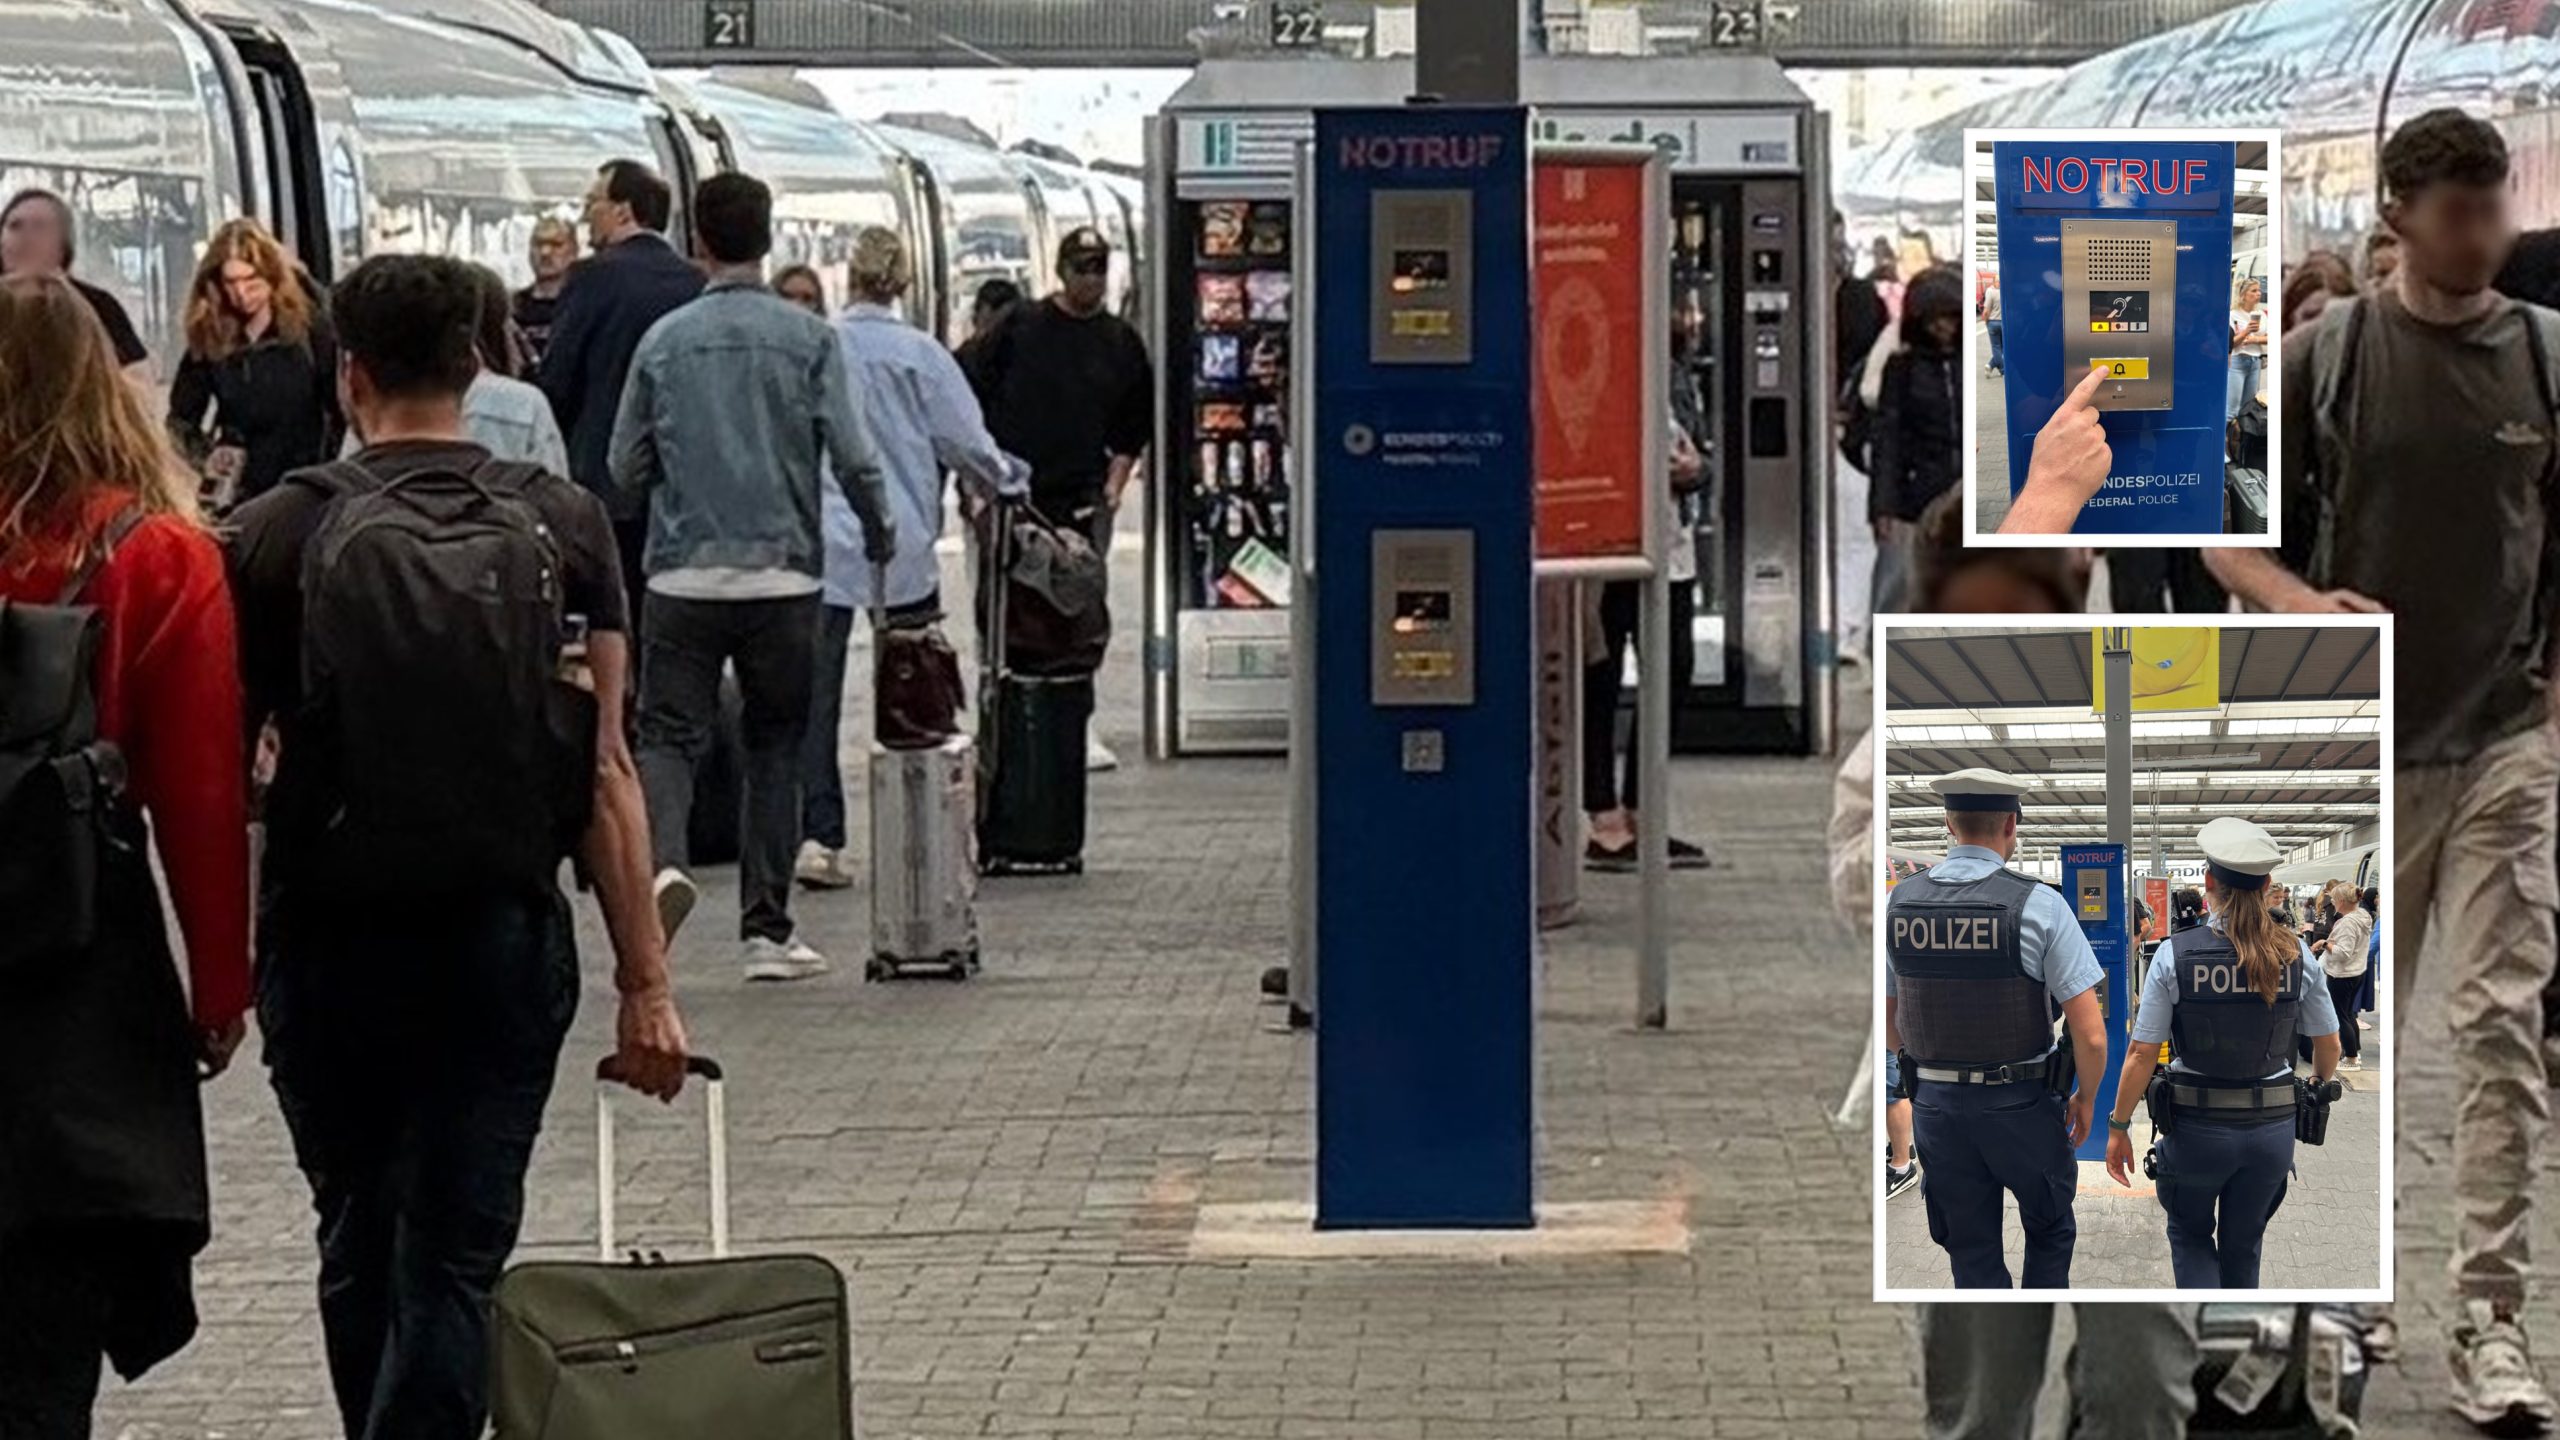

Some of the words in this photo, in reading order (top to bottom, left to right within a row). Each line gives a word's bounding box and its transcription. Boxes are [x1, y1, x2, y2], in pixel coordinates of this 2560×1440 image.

[714, 12, 746, 43] 21
[1276, 13, 1317, 43] 22
[1717, 11, 1757, 43] 23
[1340, 135, 1502, 168] NOTRUF
[2023, 156, 2208, 195] NOTRUF
[2102, 473, 2200, 489] NDESPOLIZEI
[2138, 494, 2179, 505] POLICE
[2067, 852, 2116, 863] NOTRUF
[1894, 917, 1999, 950] POLIZEI
[2193, 964, 2292, 994] POLEI
